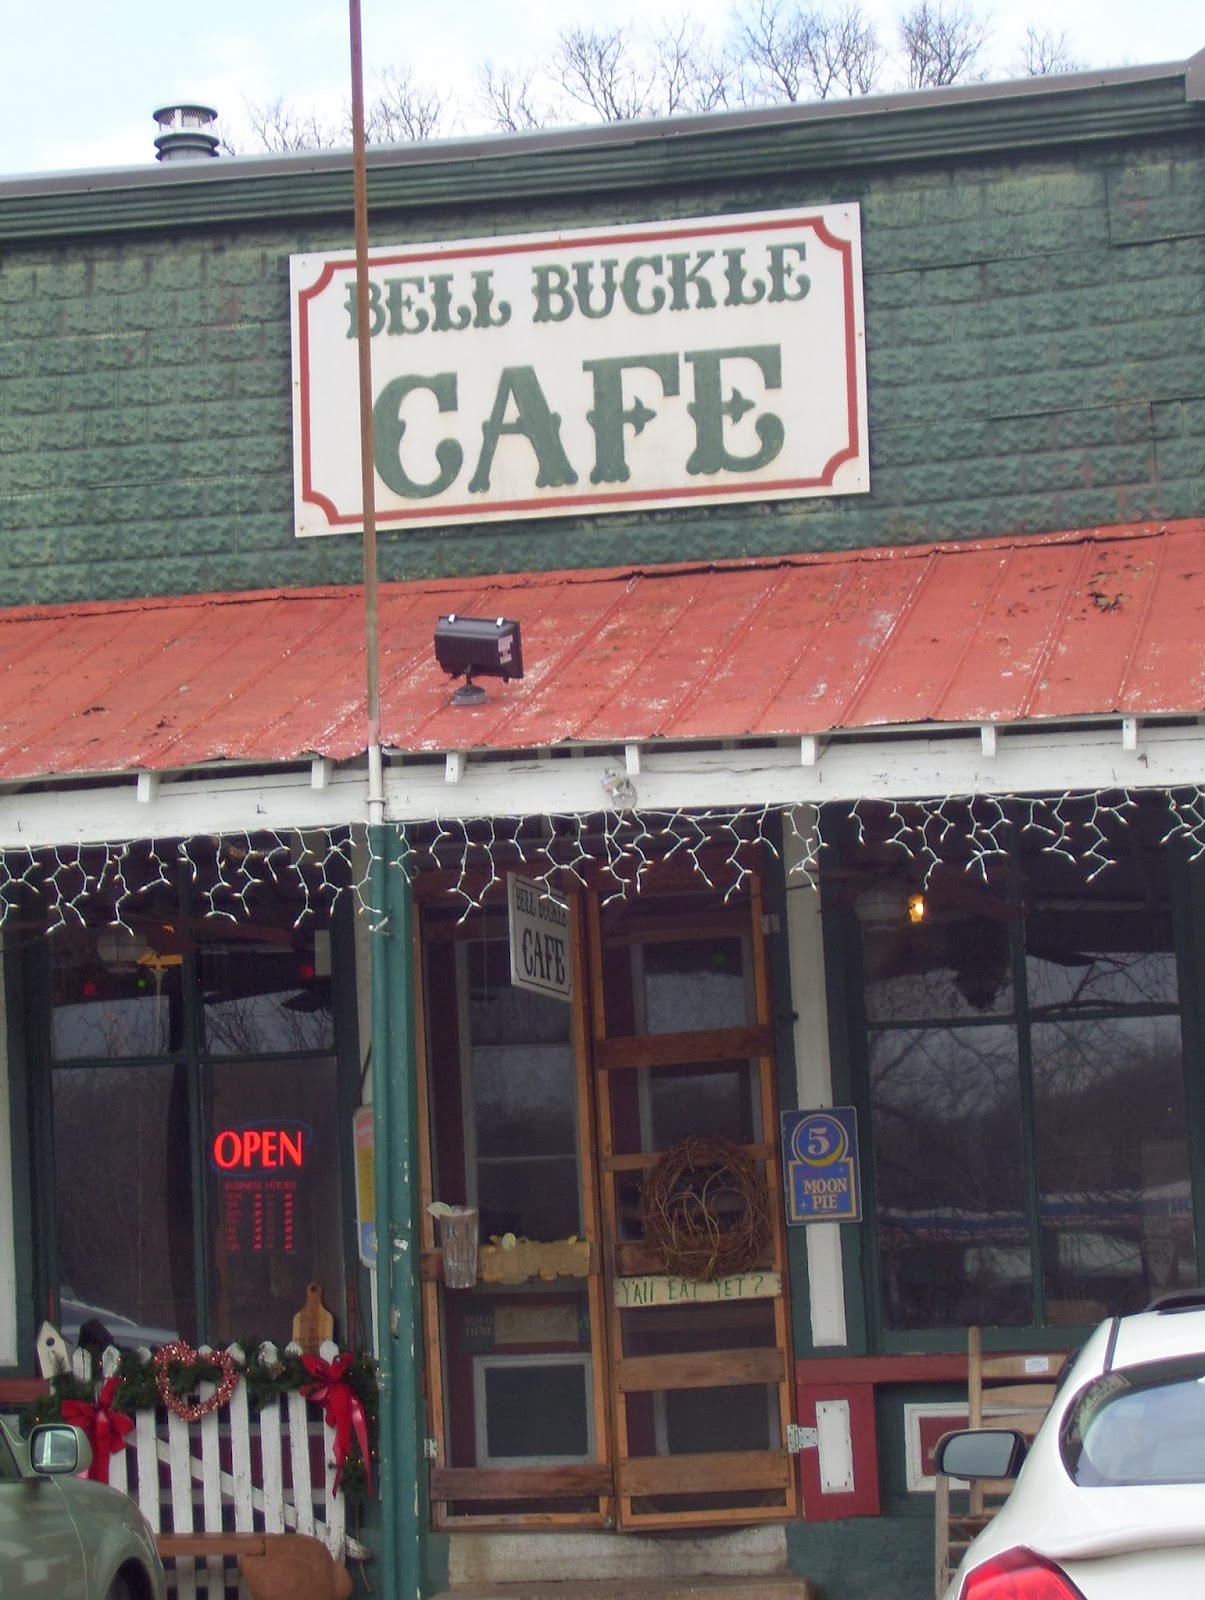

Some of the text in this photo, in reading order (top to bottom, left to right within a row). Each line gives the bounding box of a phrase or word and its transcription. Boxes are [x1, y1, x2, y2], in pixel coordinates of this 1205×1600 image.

[345, 242, 811, 340] BELL BUCKLE
[373, 343, 785, 499] CAFE
[516, 887, 536, 916] BELL
[522, 927, 565, 985] CAFE
[213, 1130, 303, 1169] OPEN
[803, 1178, 848, 1195] MOON
[812, 1194, 838, 1210] PIE
[668, 1278, 699, 1300] EAT
